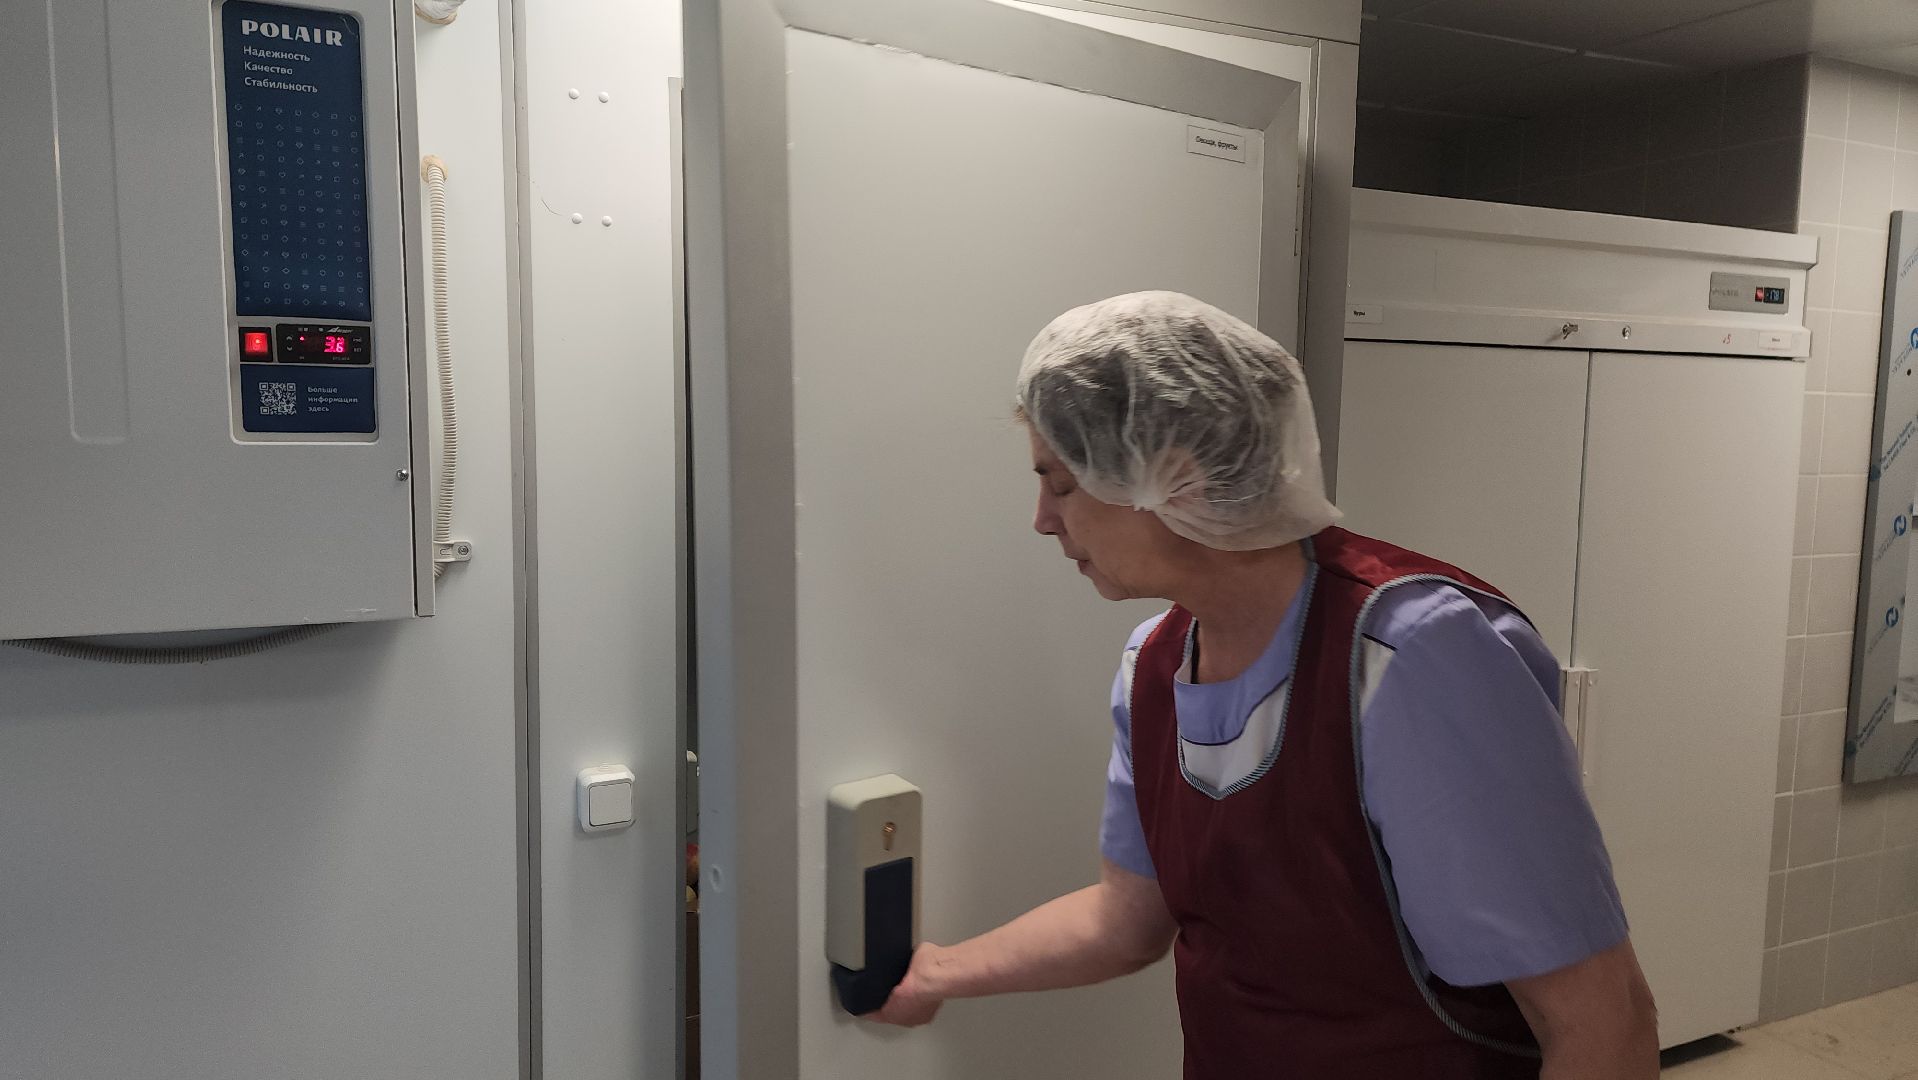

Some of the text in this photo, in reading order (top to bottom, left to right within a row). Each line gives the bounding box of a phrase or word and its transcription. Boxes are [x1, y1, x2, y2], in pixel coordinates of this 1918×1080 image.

[241, 19, 343, 47] POLAIR
[243, 45, 311, 62] Надежность
[244, 61, 293, 75] Качество
[244, 77, 318, 93] Стабильность
[307, 386, 338, 394] Больше
[308, 405, 330, 413] здесь
